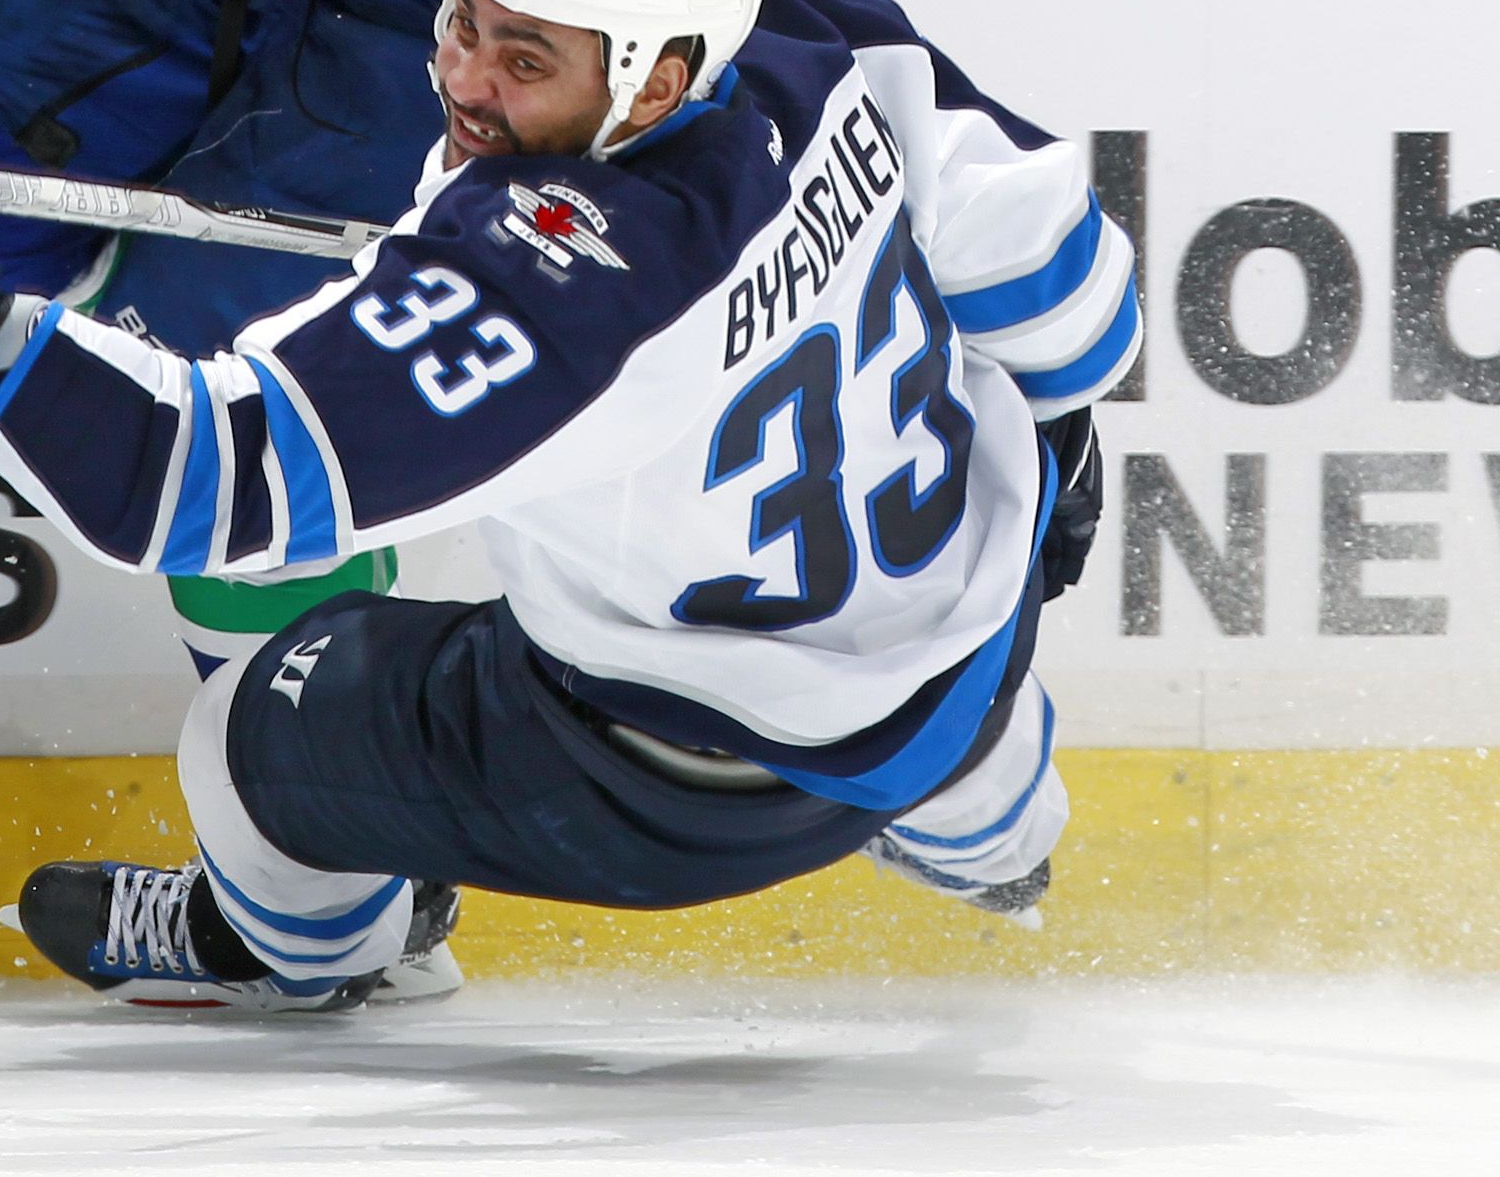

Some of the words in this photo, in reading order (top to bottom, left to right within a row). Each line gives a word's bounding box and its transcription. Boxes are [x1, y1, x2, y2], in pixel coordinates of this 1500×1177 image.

[517, 226, 552, 252] JETS
[545, 184, 606, 231] WINNIPEG
[350, 265, 538, 418] 33
[668, 200, 977, 632] 33
[1120, 451, 1500, 636] NE
